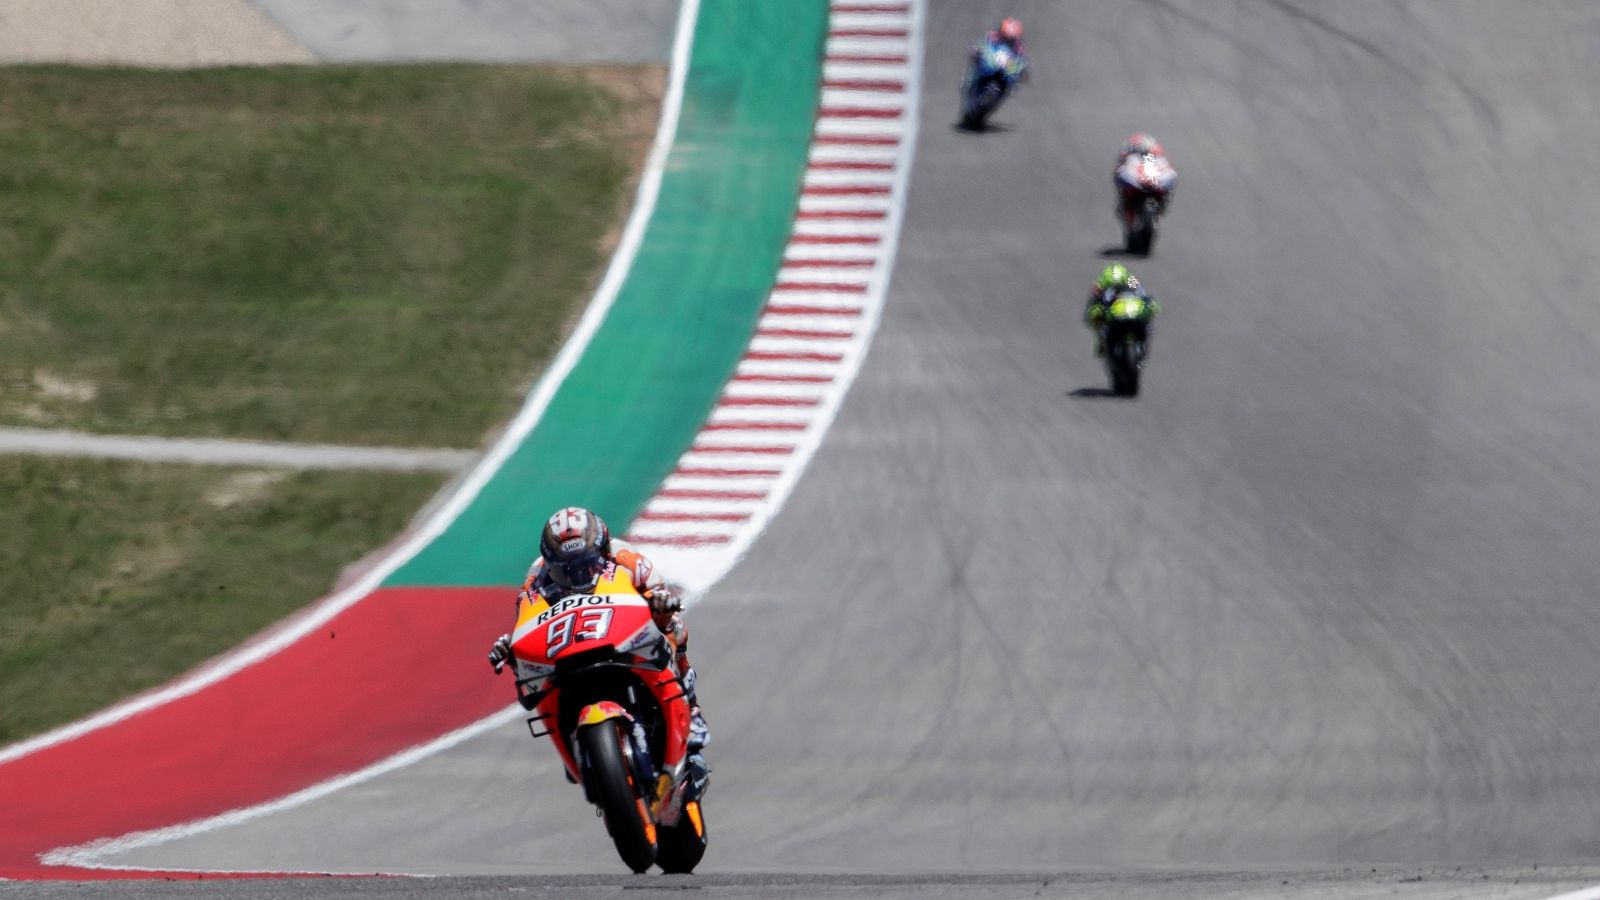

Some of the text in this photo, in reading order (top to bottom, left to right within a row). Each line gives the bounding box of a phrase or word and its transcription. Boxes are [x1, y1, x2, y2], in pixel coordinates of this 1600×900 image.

[549, 507, 587, 537] 93
[538, 595, 614, 625] REPSOL
[546, 607, 614, 659] 93
